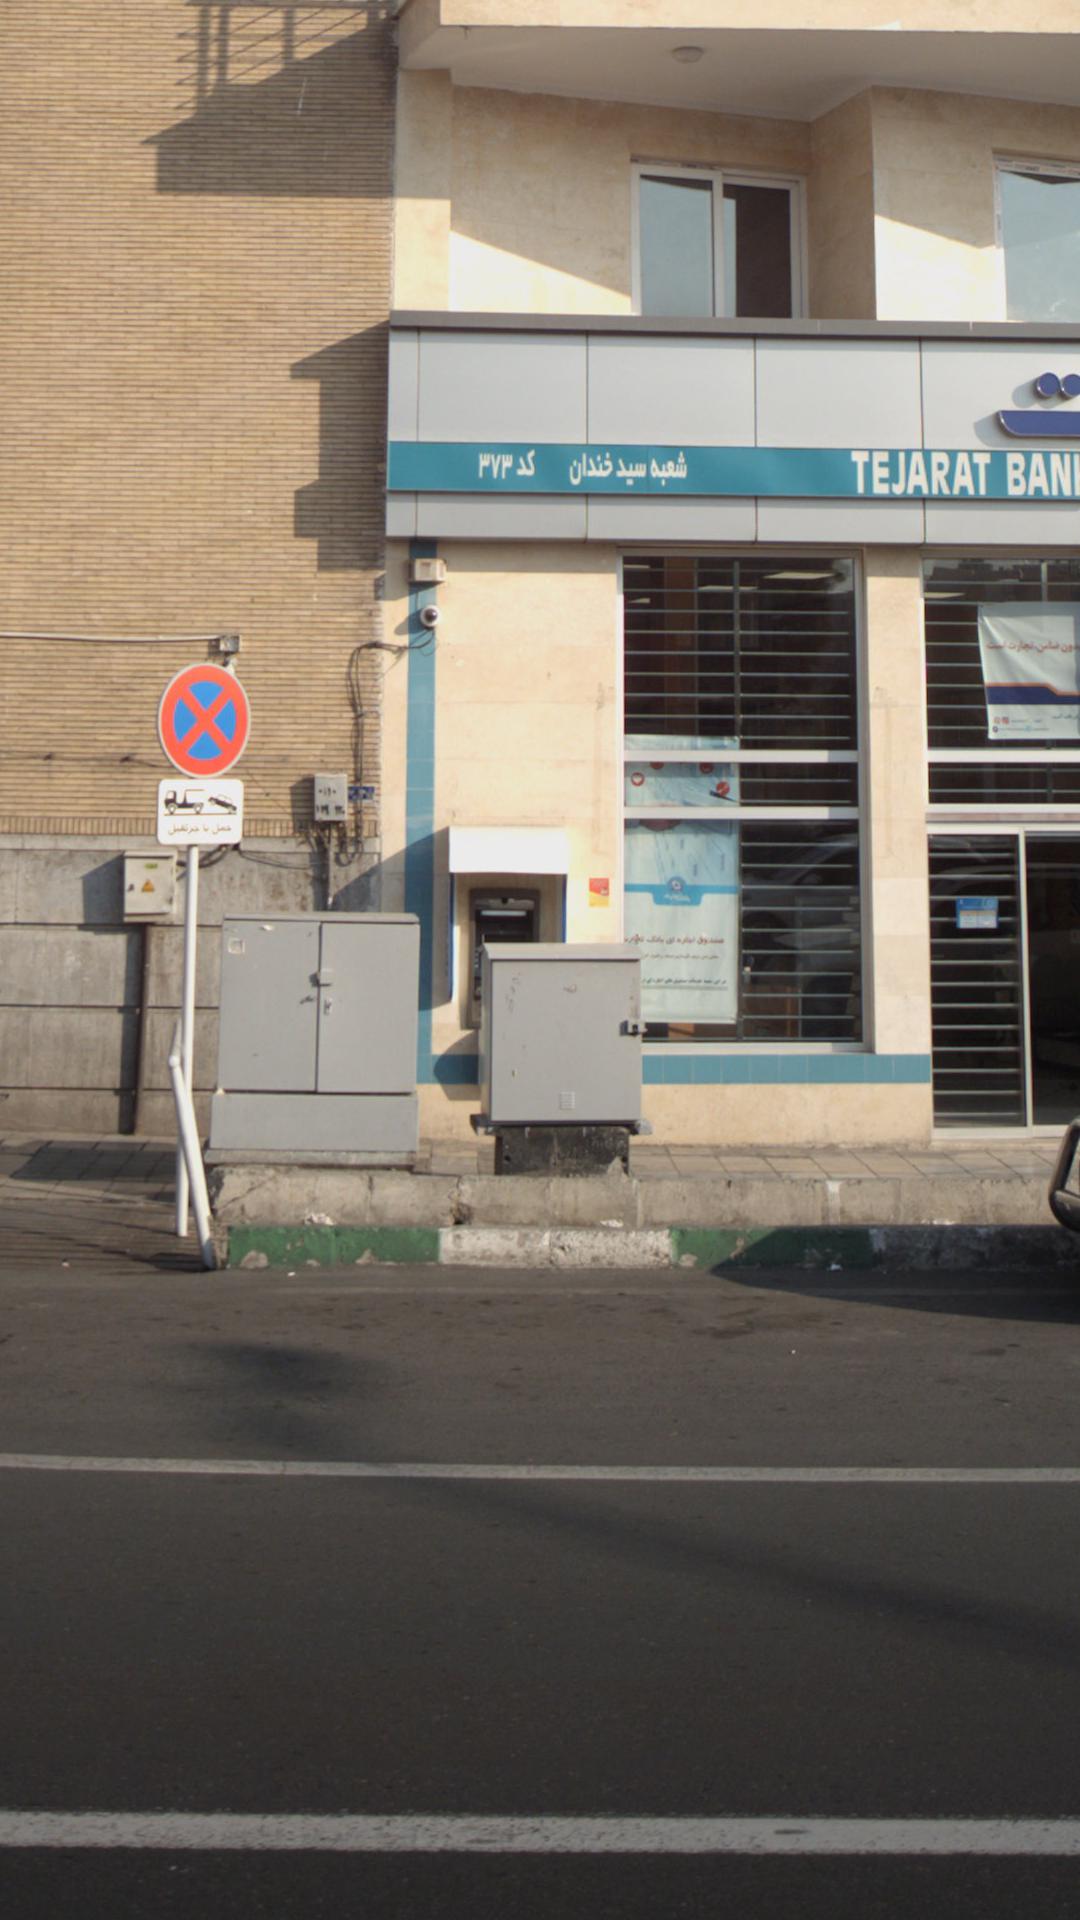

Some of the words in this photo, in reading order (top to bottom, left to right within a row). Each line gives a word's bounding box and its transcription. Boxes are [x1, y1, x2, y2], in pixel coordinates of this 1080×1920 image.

[478, 452, 513, 480] ۳۷۳
[516, 449, 536, 477] کد
[569, 451, 613, 486] خندان
[615, 458, 647, 486] سید
[650, 451, 688, 487] شعبه
[851, 450, 991, 496] TEJARAT
[168, 823, 200, 836] جرثقیل
[202, 823, 209, 832] با
[212, 824, 232, 836] حمل
[646, 935, 664, 944] بانک
[677, 935, 695, 946] اجاره
[697, 934, 724, 946] صندوق
